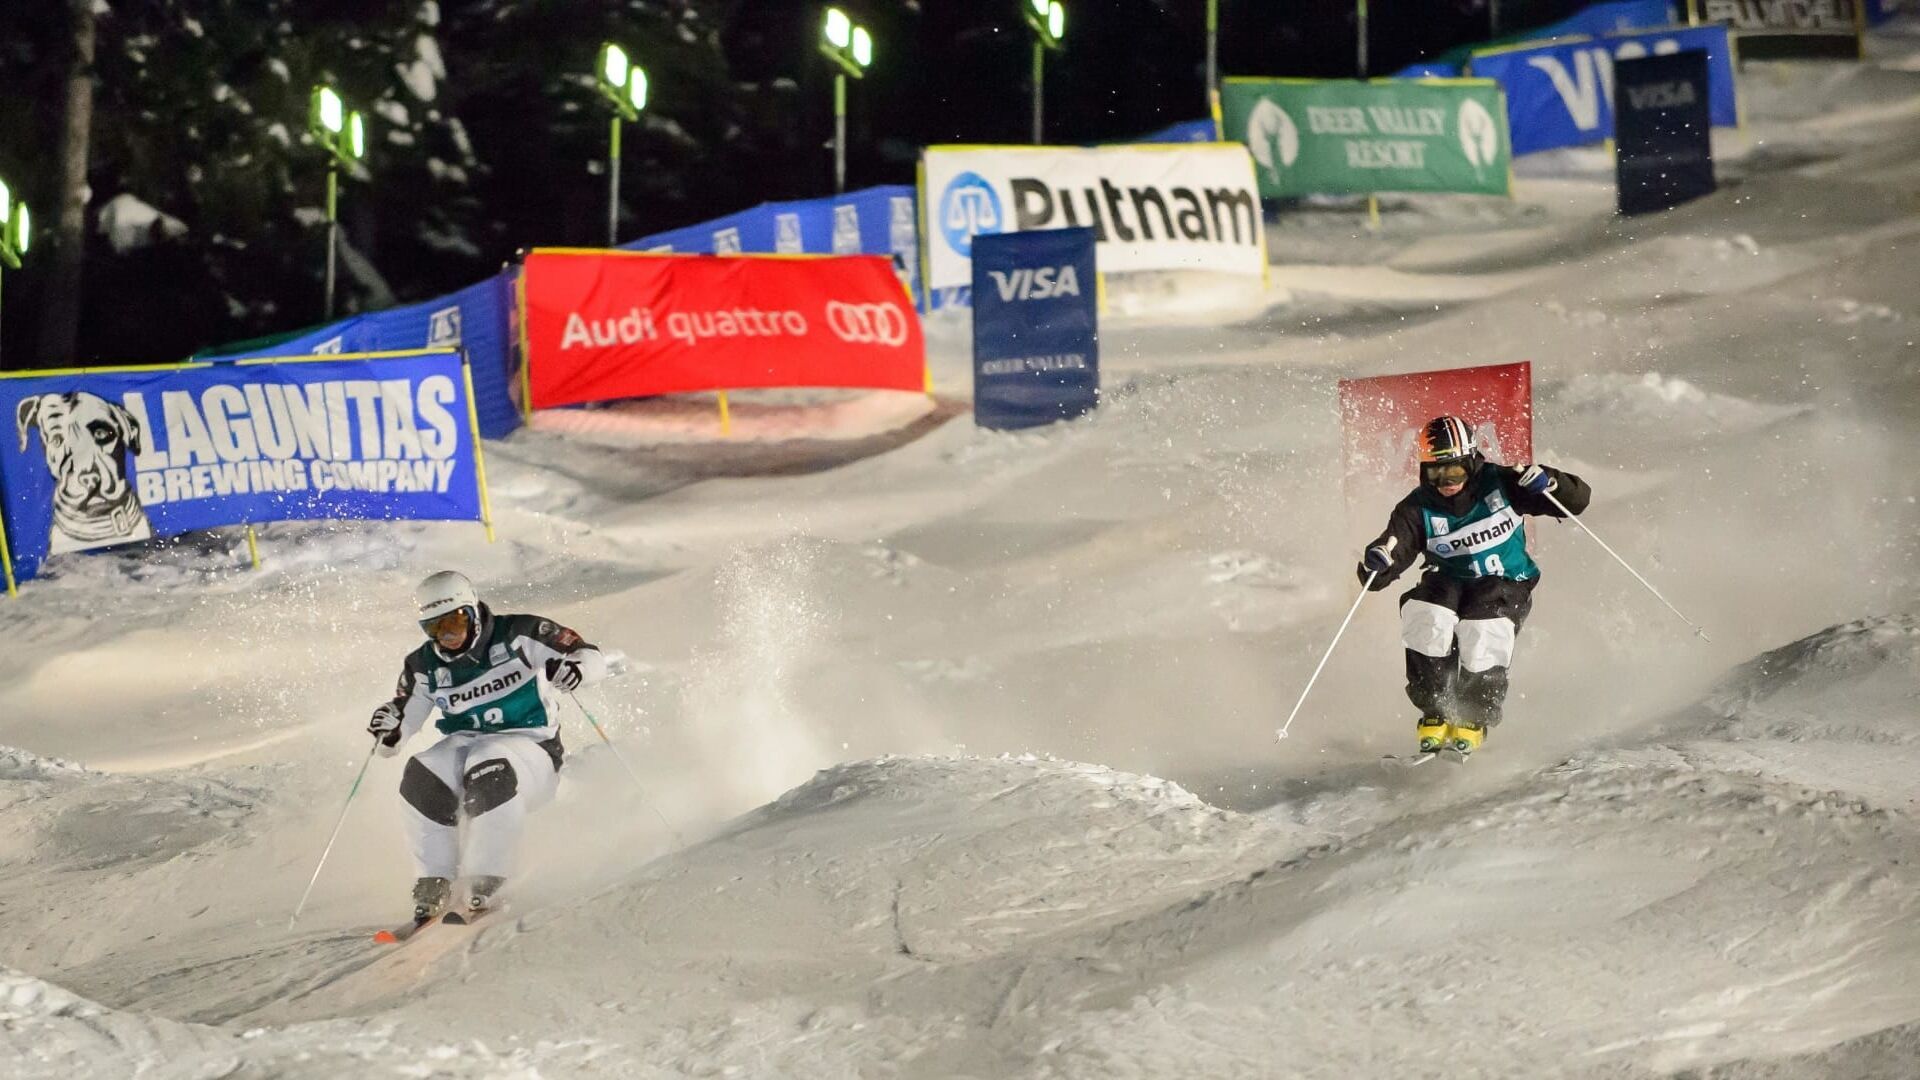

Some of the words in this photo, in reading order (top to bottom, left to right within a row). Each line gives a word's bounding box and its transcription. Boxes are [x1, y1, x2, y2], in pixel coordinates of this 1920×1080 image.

[1306, 106, 1369, 134] DEER
[1367, 106, 1446, 136] VALLEY
[1345, 140, 1427, 169] RESORT
[1010, 177, 1257, 246] Putnam
[988, 265, 1081, 301] VISA
[561, 307, 657, 350] Audi
[668, 306, 808, 344] quattro
[122, 374, 458, 471] LAGUNITAS
[135, 459, 307, 506] BREWING
[310, 459, 457, 494] COMPANY
[1450, 517, 1514, 551] Putnam
[449, 670, 522, 707] Putnam
